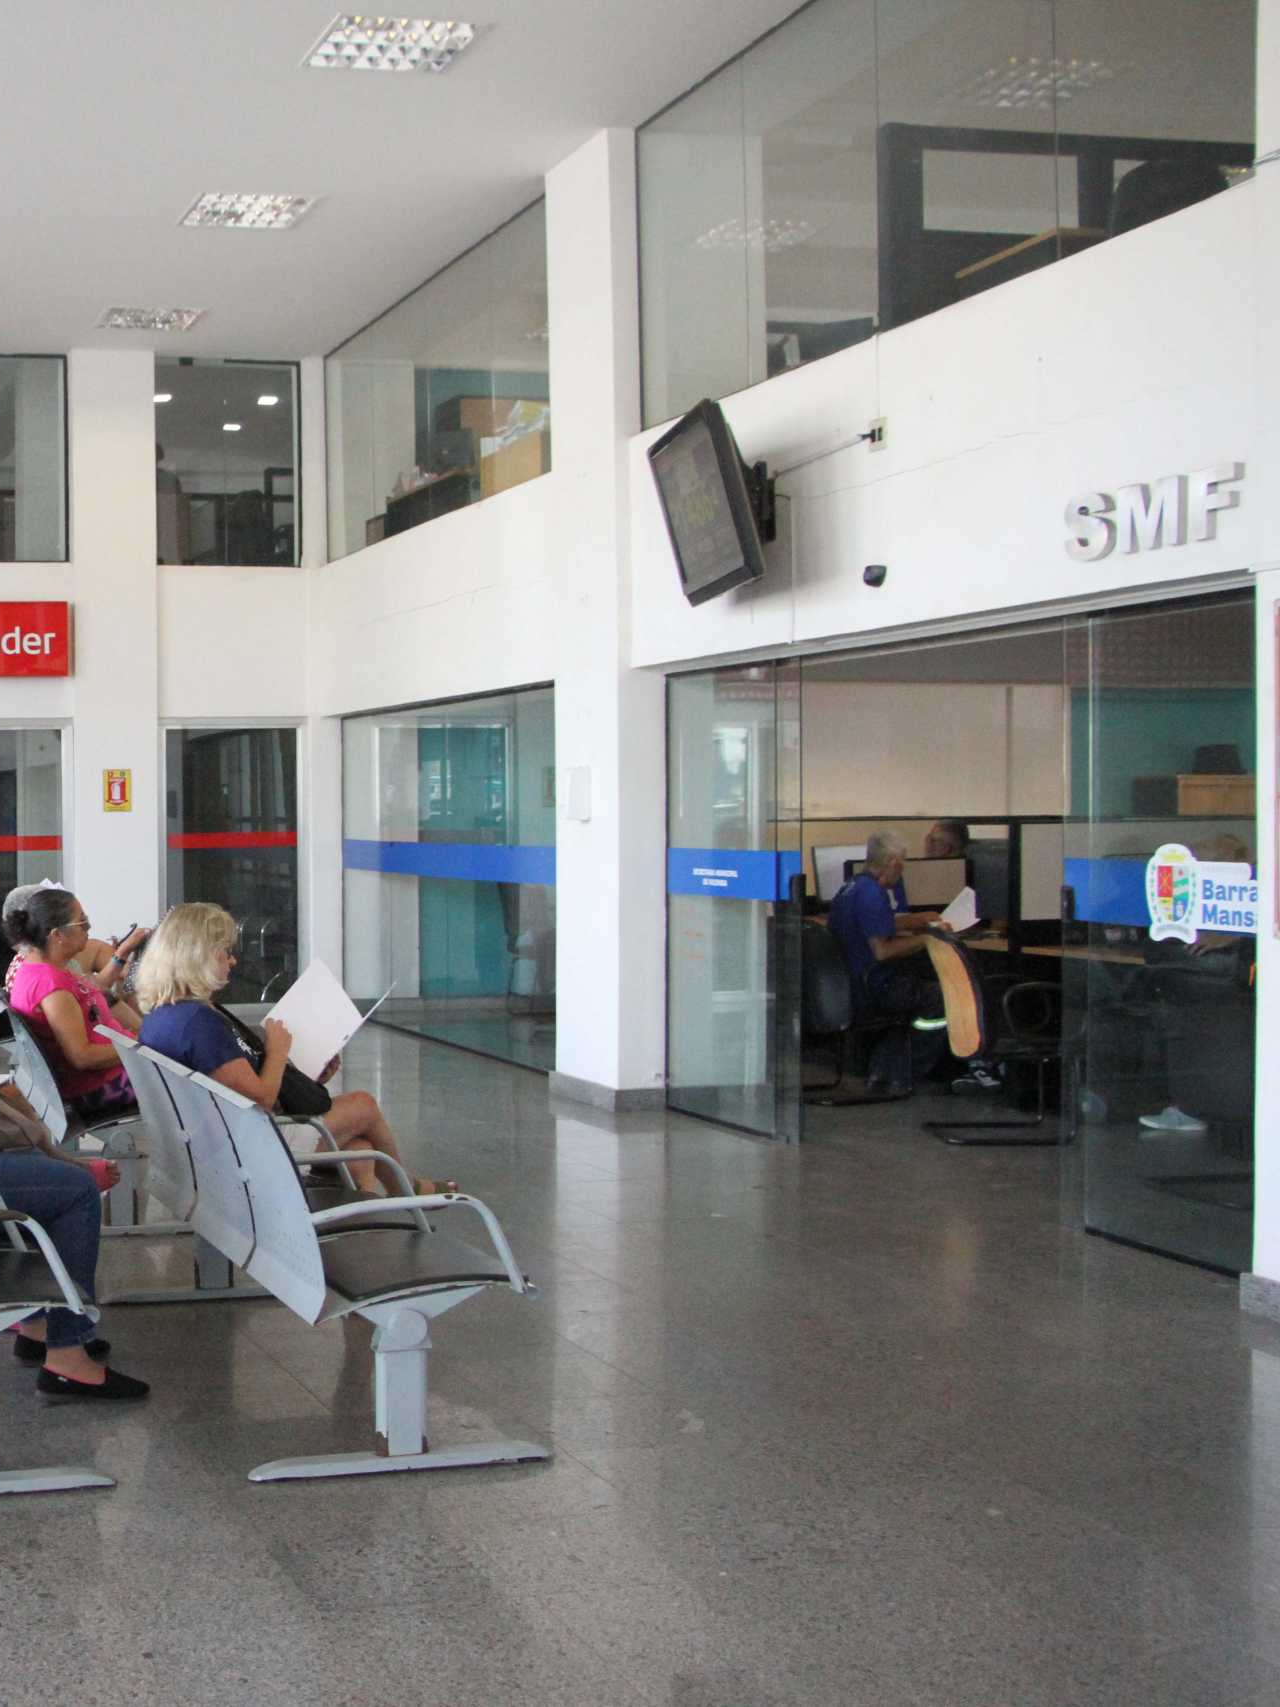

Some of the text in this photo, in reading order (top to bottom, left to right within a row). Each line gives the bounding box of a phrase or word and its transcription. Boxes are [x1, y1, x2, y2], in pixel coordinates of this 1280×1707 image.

[1064, 462, 1245, 562] SMF
[1202, 879, 1257, 902] Barra
[1202, 903, 1257, 927] Mans
